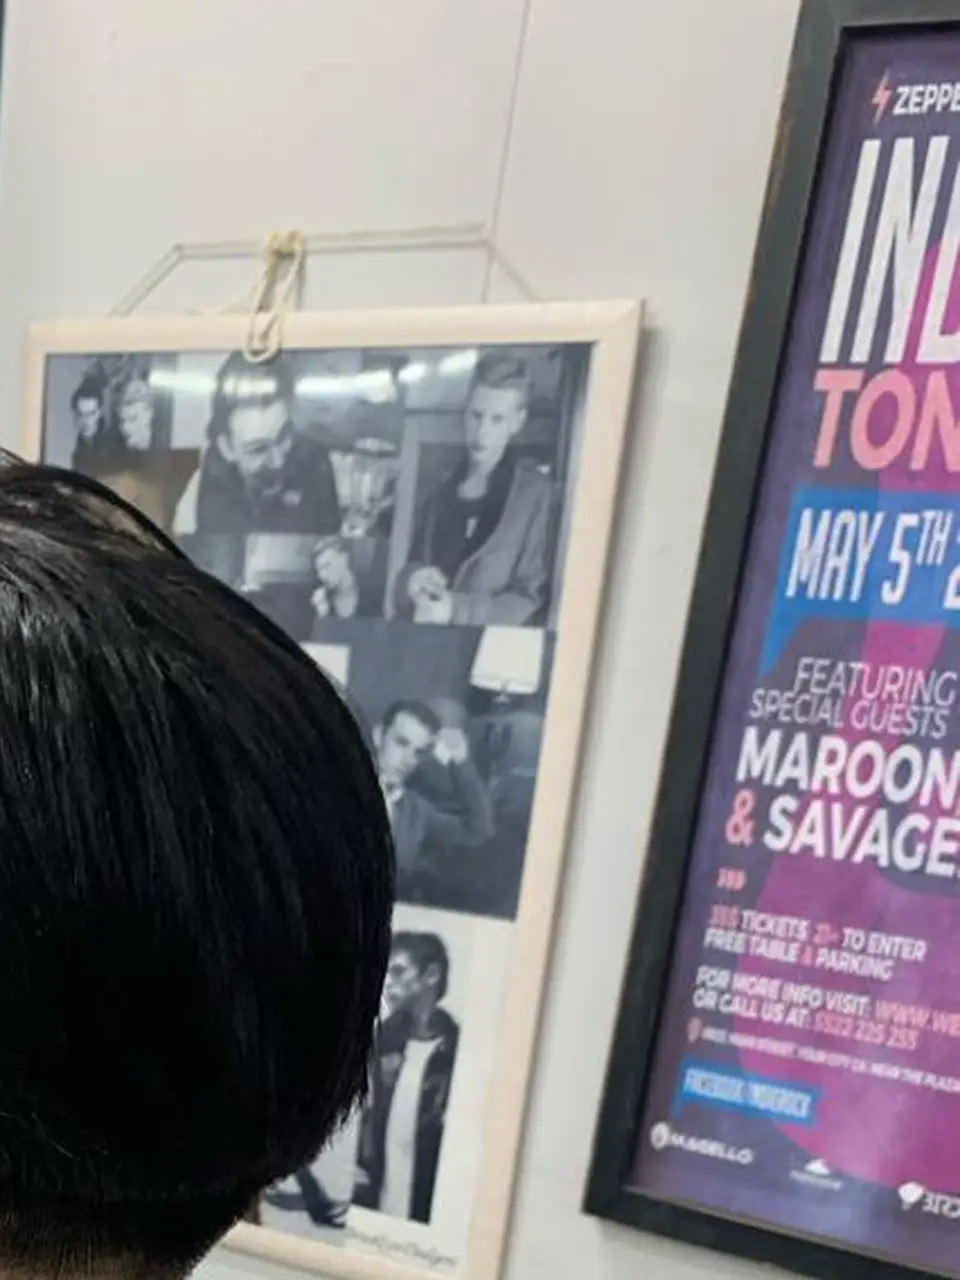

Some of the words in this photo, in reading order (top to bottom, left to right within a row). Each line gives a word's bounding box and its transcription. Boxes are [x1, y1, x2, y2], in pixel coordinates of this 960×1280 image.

[786, 507, 885, 603] MAY
[793, 656, 958, 706] FEATURING
[749, 688, 845, 728] SPECIAL
[850, 700, 950, 739] GUESTS
[735, 725, 960, 810] MAROON
[725, 788, 756, 847] &
[703, 927, 746, 954] FREE
[749, 935, 801, 963] TABLE
[815, 948, 895, 981] PARKING
[741, 909, 811, 942] TICKETS
[843, 926, 865, 950] TO
[867, 932, 928, 962] ENTER
[692, 988, 717, 1010] OR
[718, 993, 758, 1019] CALL
[760, 1001, 786, 1023] US
[695, 965, 731, 990] FOR
[732, 972, 782, 999] MORE
[782, 982, 823, 1007] INFO
